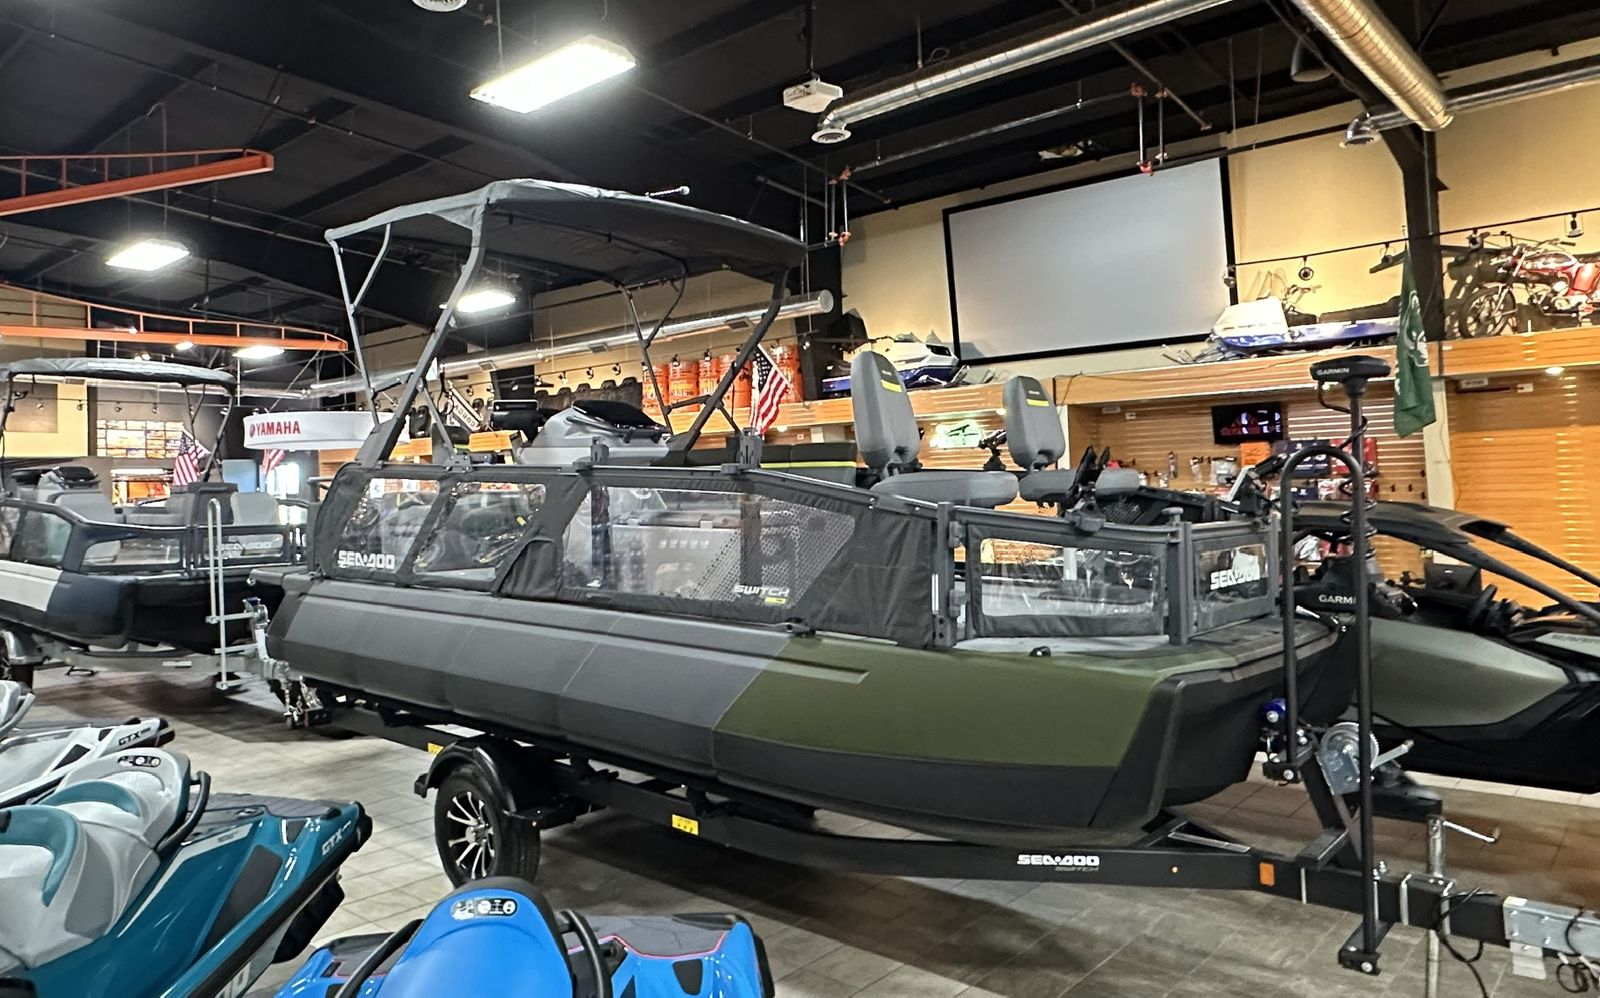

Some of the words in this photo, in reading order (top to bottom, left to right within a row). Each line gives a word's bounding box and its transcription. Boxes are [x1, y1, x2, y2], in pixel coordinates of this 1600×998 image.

[1316, 367, 1350, 376] GARMIN
[256, 420, 301, 436] YAMAHA
[733, 584, 790, 597] SWITCH
[1318, 594, 1356, 605] GARMI
[119, 731, 140, 746] GTX
[322, 828, 342, 855] GTX
